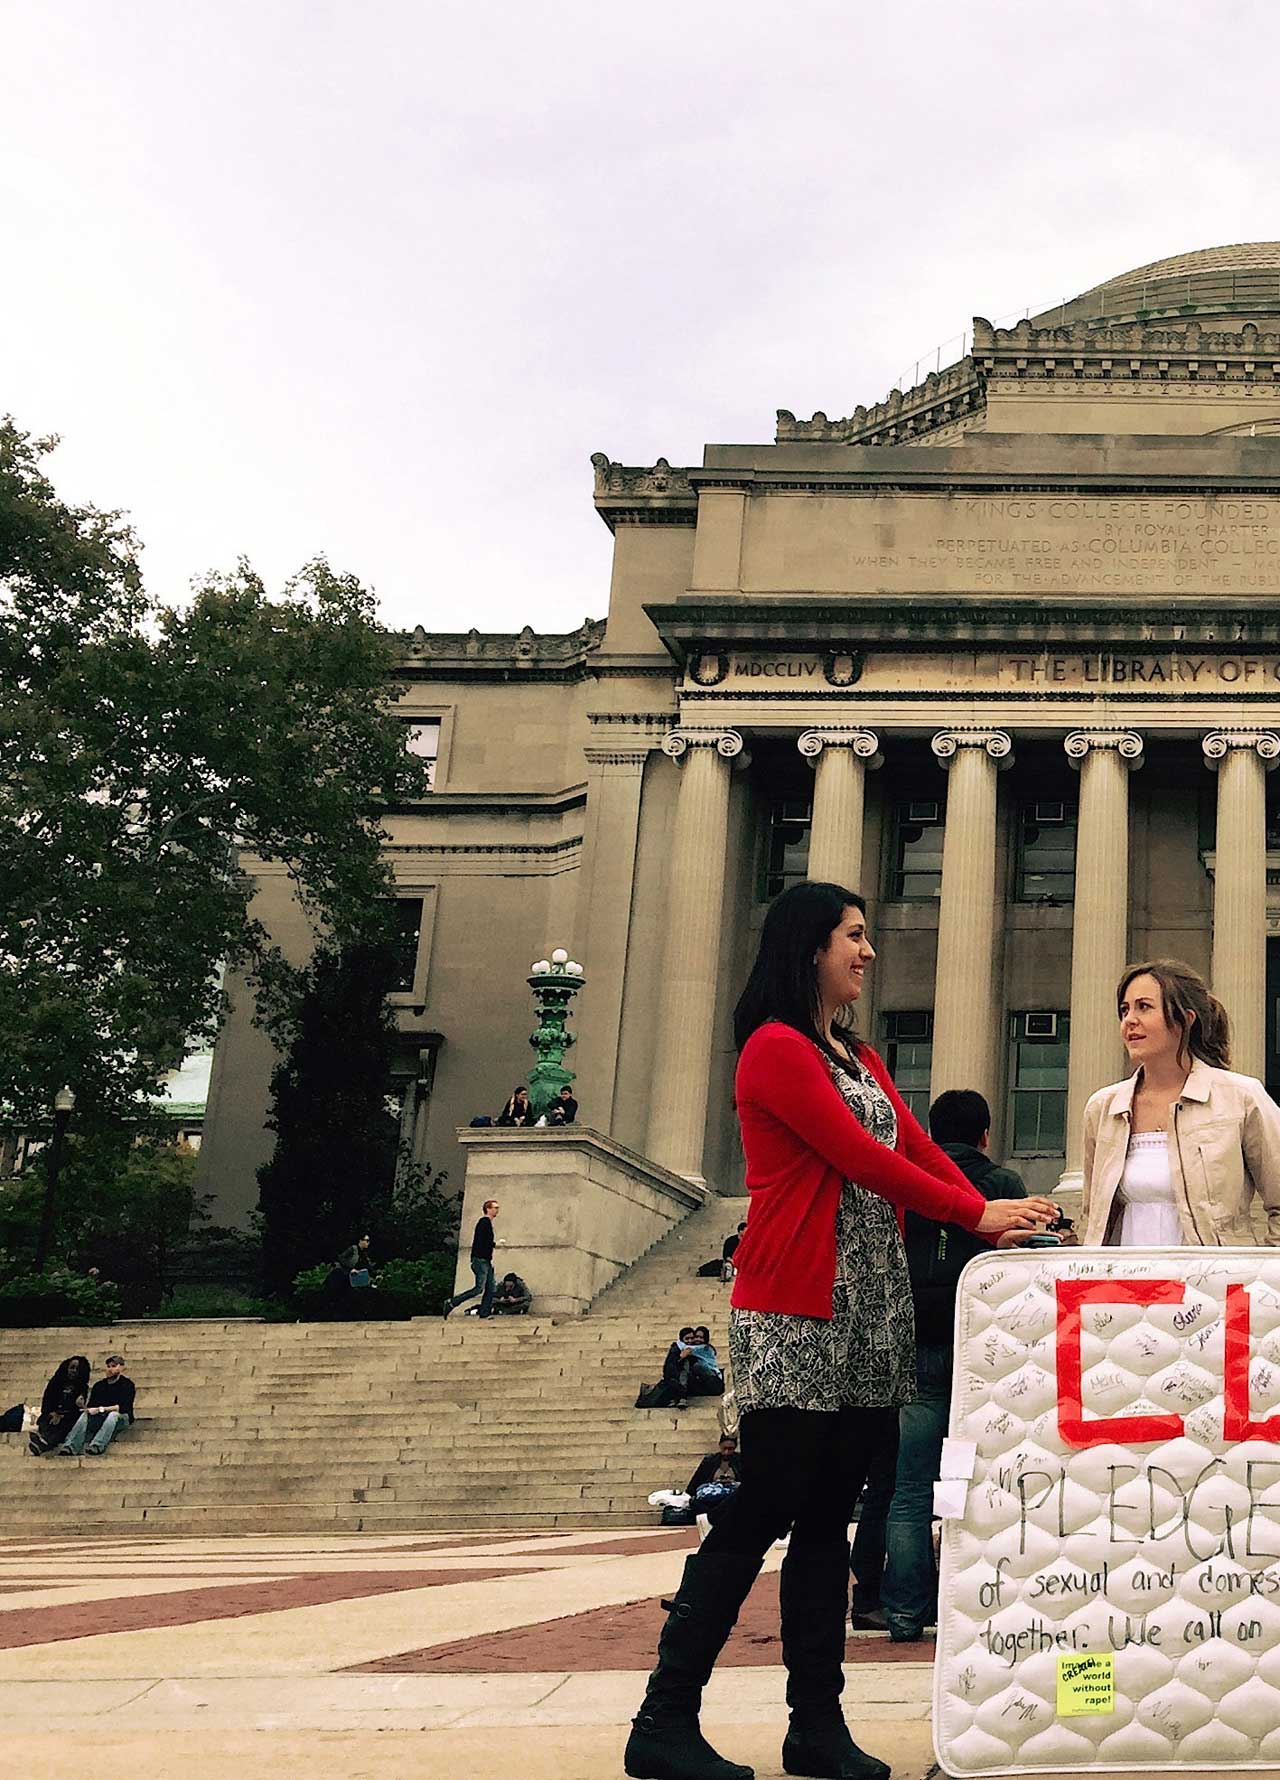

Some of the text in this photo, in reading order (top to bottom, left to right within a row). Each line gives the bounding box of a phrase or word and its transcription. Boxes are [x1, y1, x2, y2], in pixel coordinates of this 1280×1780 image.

[1049, 503, 1151, 520] COLLEGE
[1164, 503, 1270, 520] FOUNDED
[1104, 524, 1124, 536] BY
[1134, 524, 1186, 536] ROYAL
[1195, 525, 1270, 537] CHARTER
[937, 539, 1051, 552] PERPETUATED
[1060, 540, 1078, 553] AS
[1088, 539, 1192, 554] COLUMBIA
[1025, 557, 1062, 569] FREE
[1070, 558, 1103, 570] AND
[975, 573, 1004, 585] FOR
[1012, 573, 1042, 585] THE
[1173, 574, 1193, 586] OF
[1201, 574, 1232, 586] THE
[734, 662, 817, 677] MDCCLIV
[1008, 659, 1067, 682] THE
[1083, 660, 1206, 683] LIBRARY
[1218, 661, 1257, 682] OF
[979, 1556, 1011, 1608] of
[1029, 1561, 1109, 1599] sexual
[1131, 1562, 1176, 1592] and
[979, 1618, 1090, 1670] together.
[1108, 1615, 1163, 1652] We
[1183, 1610, 1222, 1644] call
[1236, 1619, 1263, 1642] on
[1082, 1671, 1112, 1681] world
[1072, 1683, 1112, 1694] without
[1084, 1695, 1112, 1707] rape!
